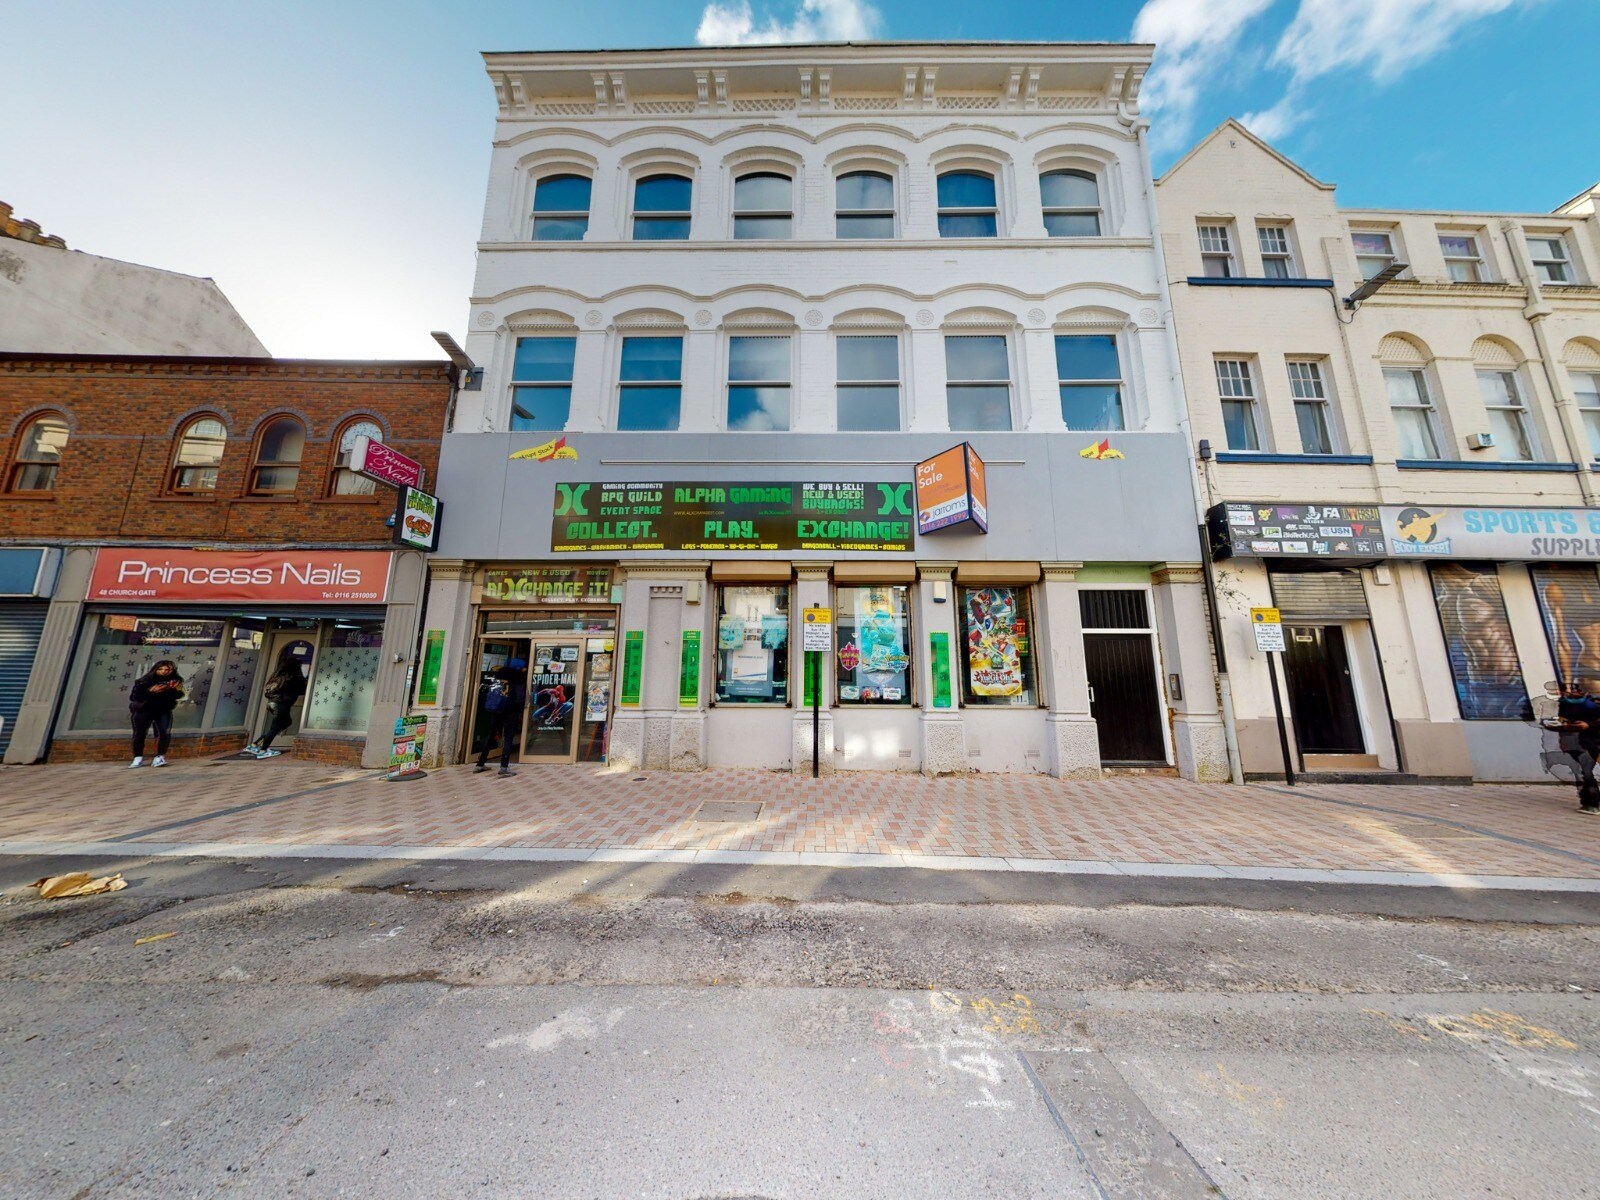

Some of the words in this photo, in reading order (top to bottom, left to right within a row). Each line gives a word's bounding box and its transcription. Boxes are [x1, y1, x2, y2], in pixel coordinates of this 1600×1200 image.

[537, 445, 554, 456] Stock
[369, 458, 415, 486] Nails
[917, 462, 936, 477] For
[802, 483, 815, 491] WE
[818, 483, 833, 491] BUY
[842, 483, 864, 491] SELL!
[918, 473, 943, 489] Sale
[601, 491, 624, 504] RPG
[674, 487, 726, 503] ALPHA
[802, 490, 824, 499] NEW
[836, 490, 864, 500] USED!
[600, 506, 631, 516] EVENT
[632, 505, 662, 516] SPACE
[802, 498, 864, 510] BUYBACKS!
[932, 499, 966, 520] jarroms
[1322, 507, 1341, 518] FA
[921, 521, 936, 532] 0116
[950, 511, 967, 523] 1999
[1462, 509, 1578, 535] SPORTS
[566, 520, 658, 540] COLLECT.
[703, 520, 760, 539] PLAY.
[797, 520, 910, 541] EXCHANGE!
[1330, 527, 1351, 535] USN
[1393, 541, 1418, 554] BODY
[1418, 542, 1451, 554] EXPERT
[117, 560, 273, 586] Princess
[280, 562, 362, 586] Nails
[138, 589, 157, 597] GATE
[321, 591, 334, 599] Tel:
